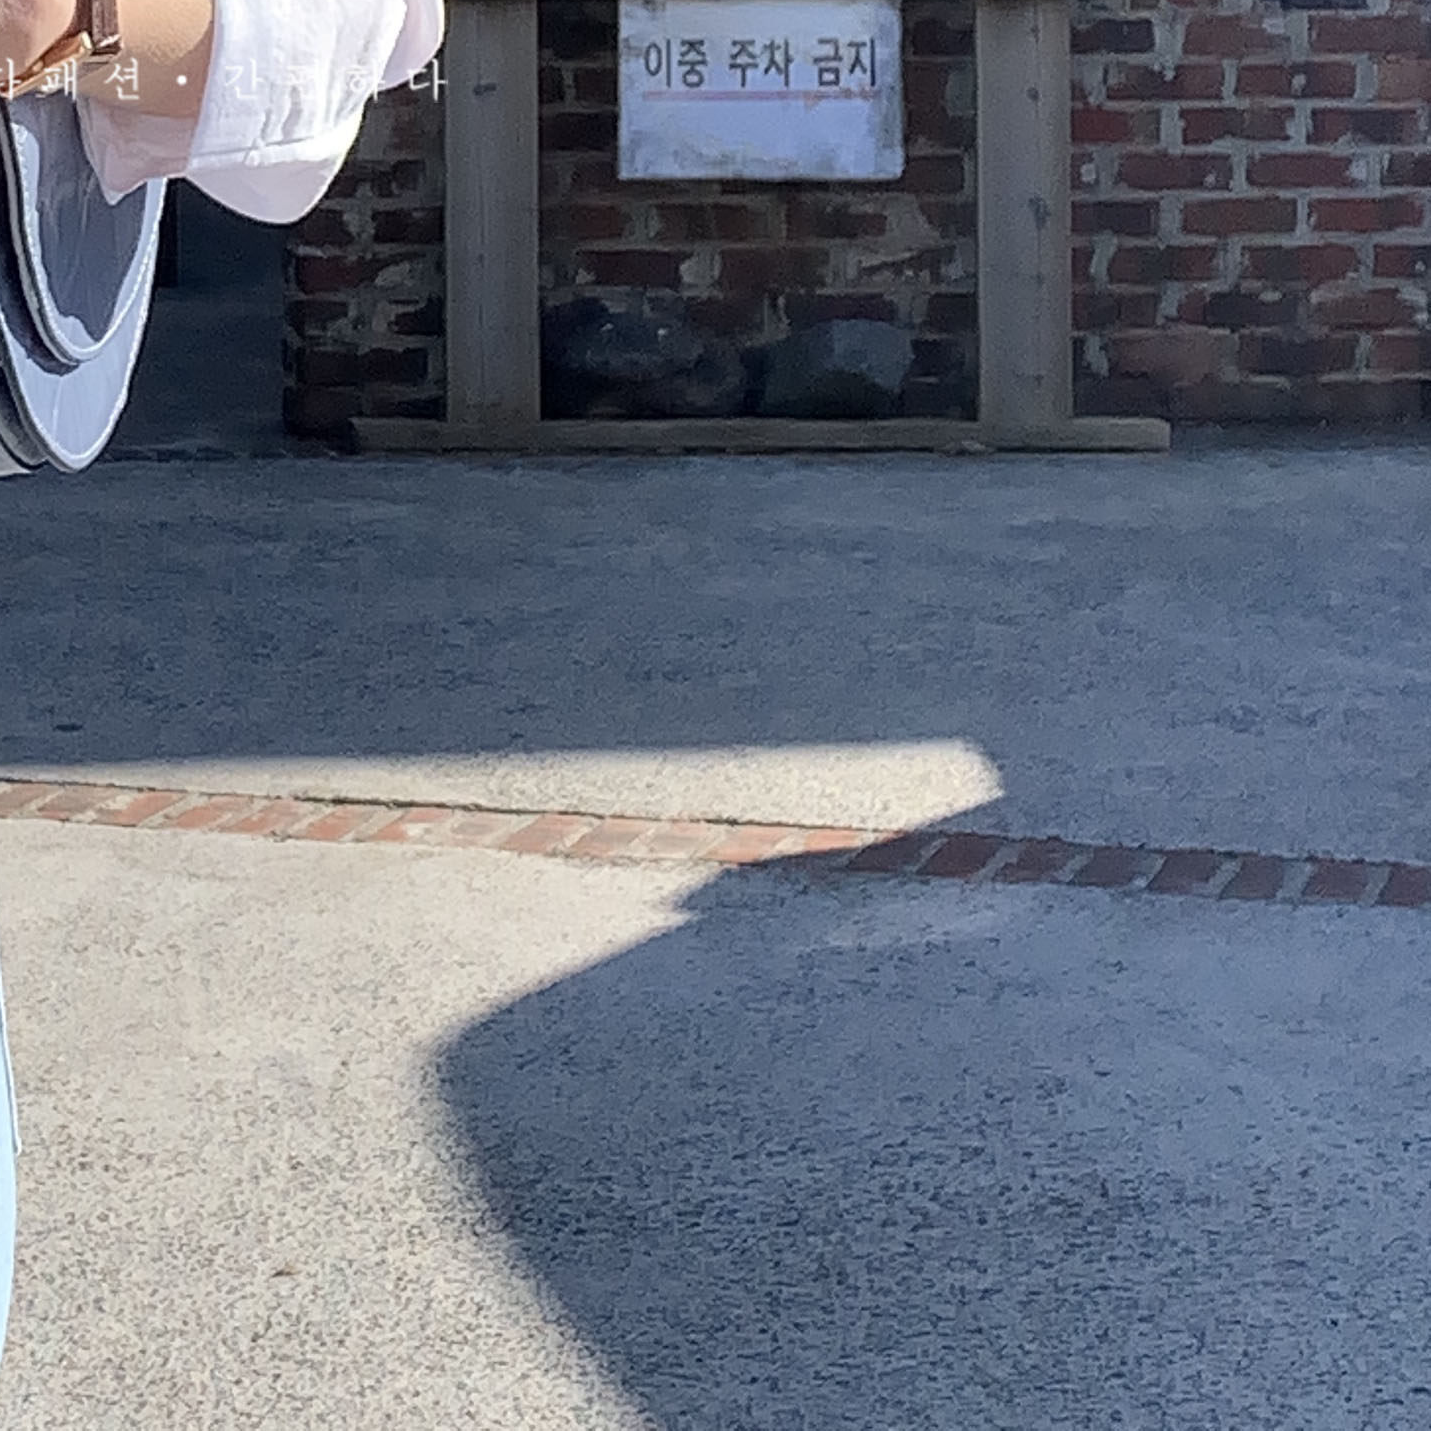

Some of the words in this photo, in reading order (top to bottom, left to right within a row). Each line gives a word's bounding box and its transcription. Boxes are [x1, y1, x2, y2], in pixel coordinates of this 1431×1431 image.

[644, 38, 708, 88] 이중
[728, 37, 794, 88] 주차
[813, 37, 876, 88] 금지
